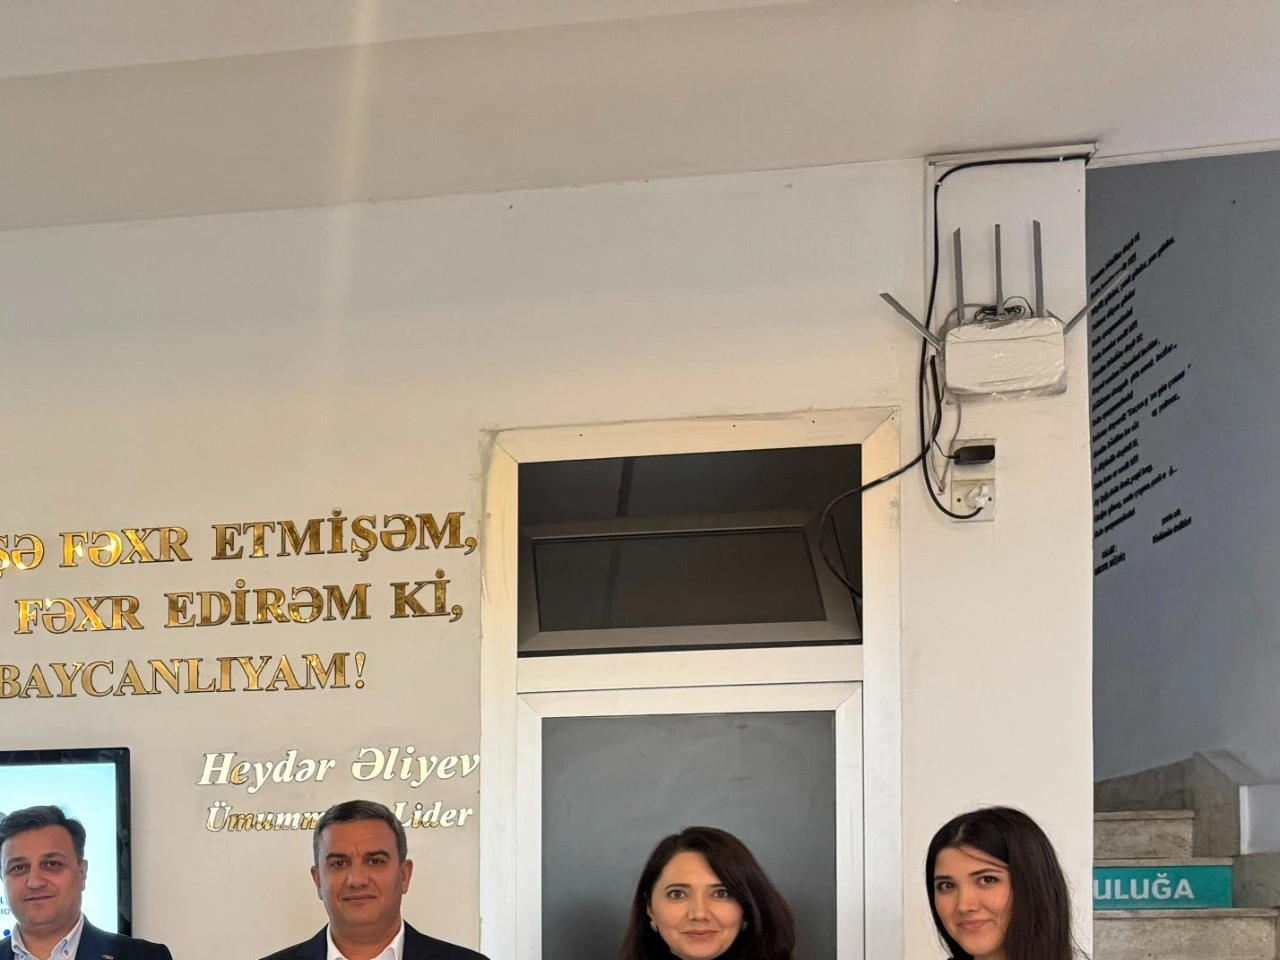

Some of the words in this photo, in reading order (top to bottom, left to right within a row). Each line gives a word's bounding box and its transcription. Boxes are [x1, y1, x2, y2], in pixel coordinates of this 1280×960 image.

[59, 526, 193, 568] FƏXR
[211, 506, 478, 561] ETMİŞƏM,
[14, 595, 145, 635] FƏXR
[164, 579, 371, 628] EDİRƏM
[390, 568, 464, 622] Kİ,
[197, 749, 336, 794] Heydər
[350, 746, 481, 789] Əliyev
[394, 801, 474, 829] Lider
